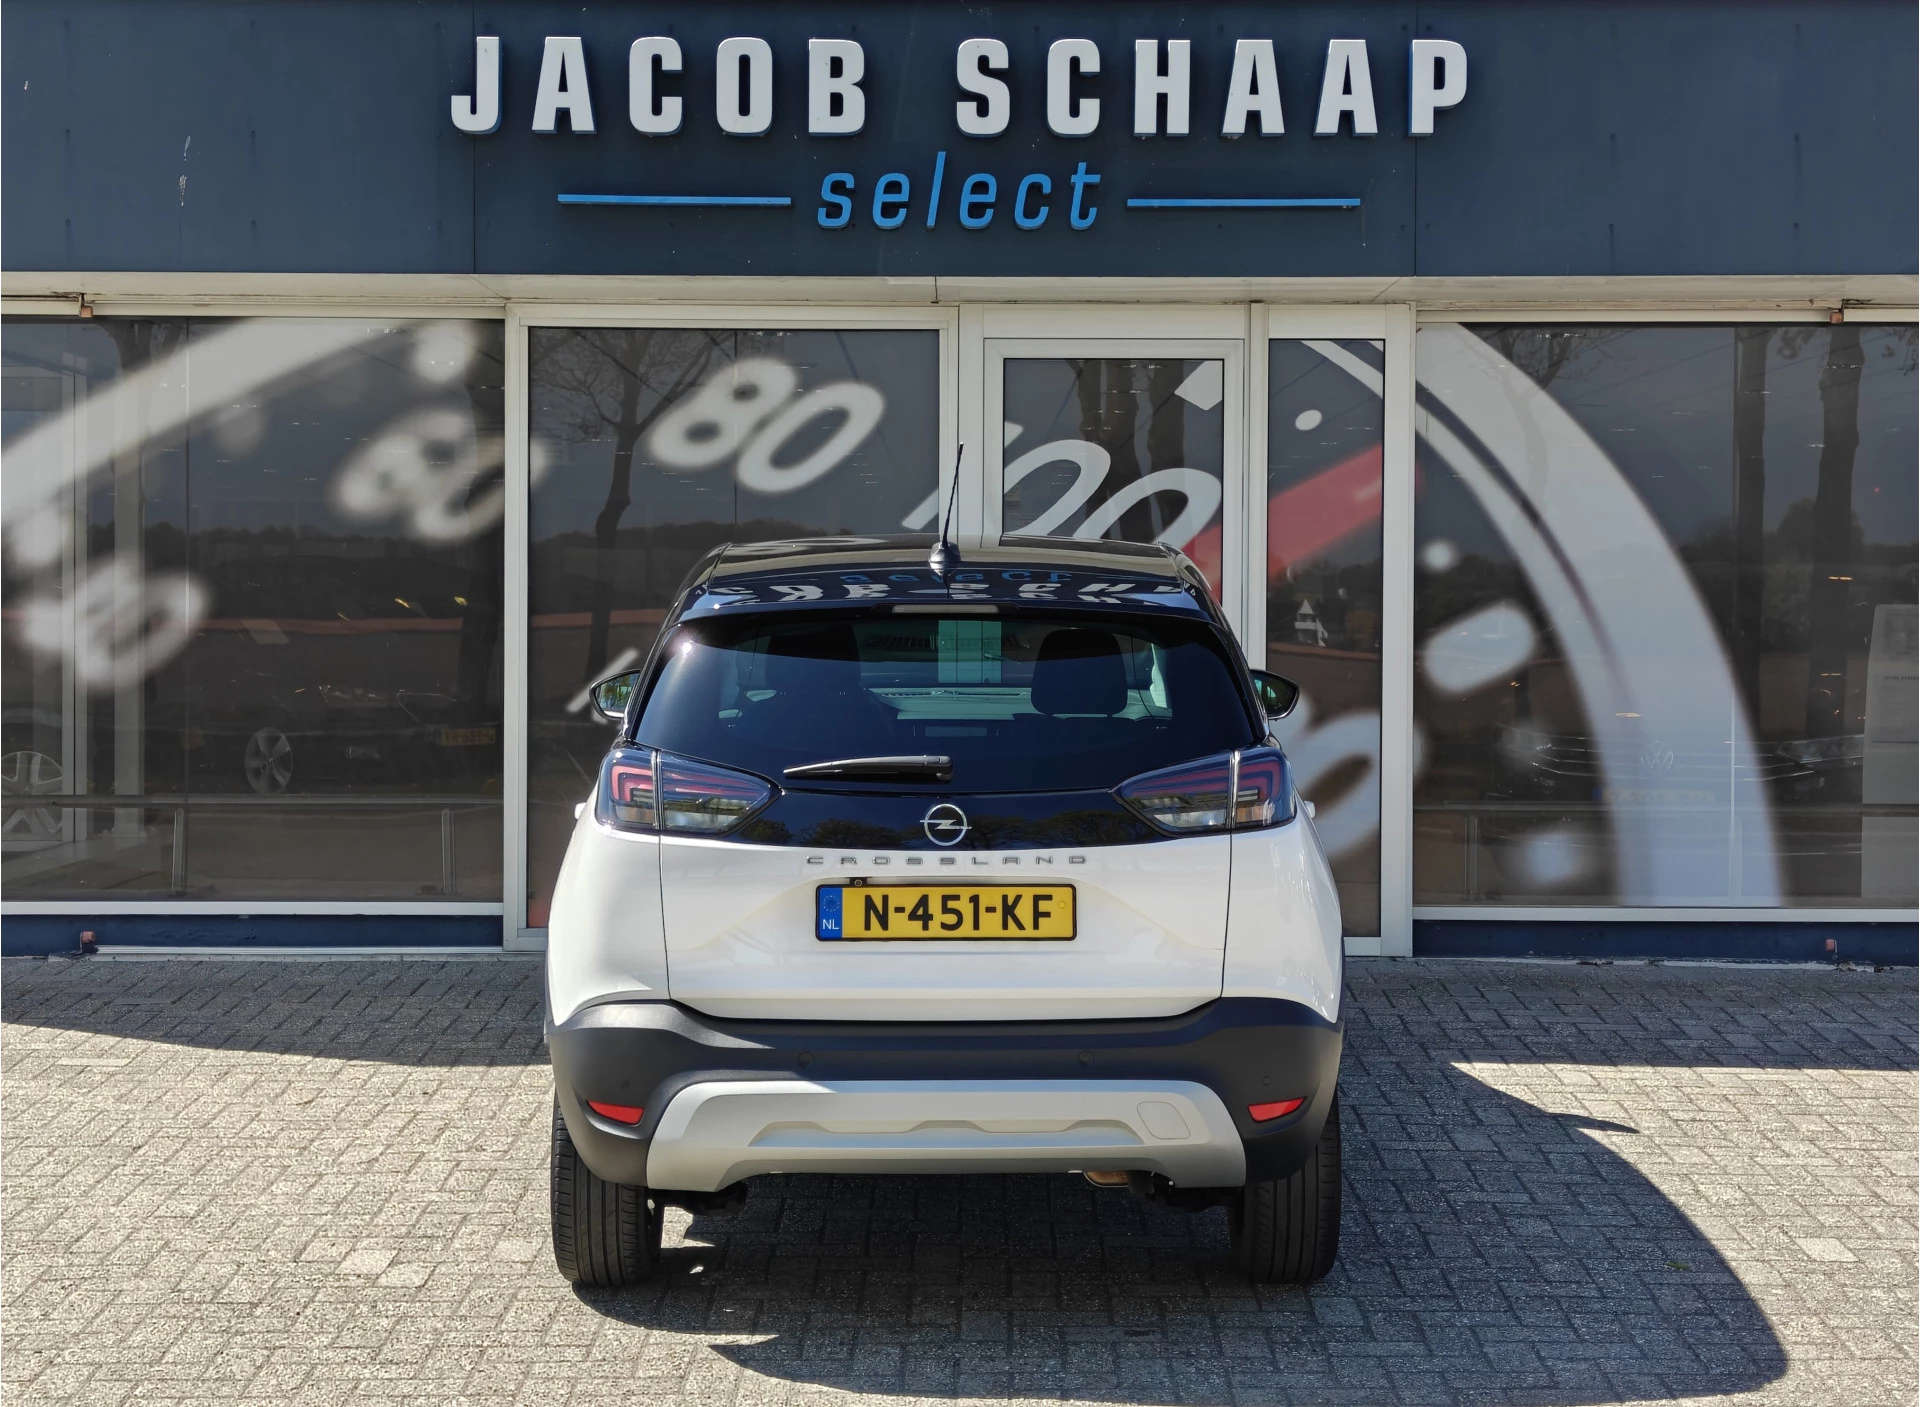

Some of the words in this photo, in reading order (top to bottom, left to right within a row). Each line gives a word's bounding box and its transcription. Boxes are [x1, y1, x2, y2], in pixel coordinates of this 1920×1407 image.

[450, 36, 866, 138] JACOB
[955, 38, 1468, 138] SCHAAP
[817, 151, 1101, 230] select
[647, 355, 887, 494] 80
[806, 855, 1088, 867] CROSSLAND
[821, 918, 840, 931] NL
[863, 893, 1054, 933] N-451-KF
